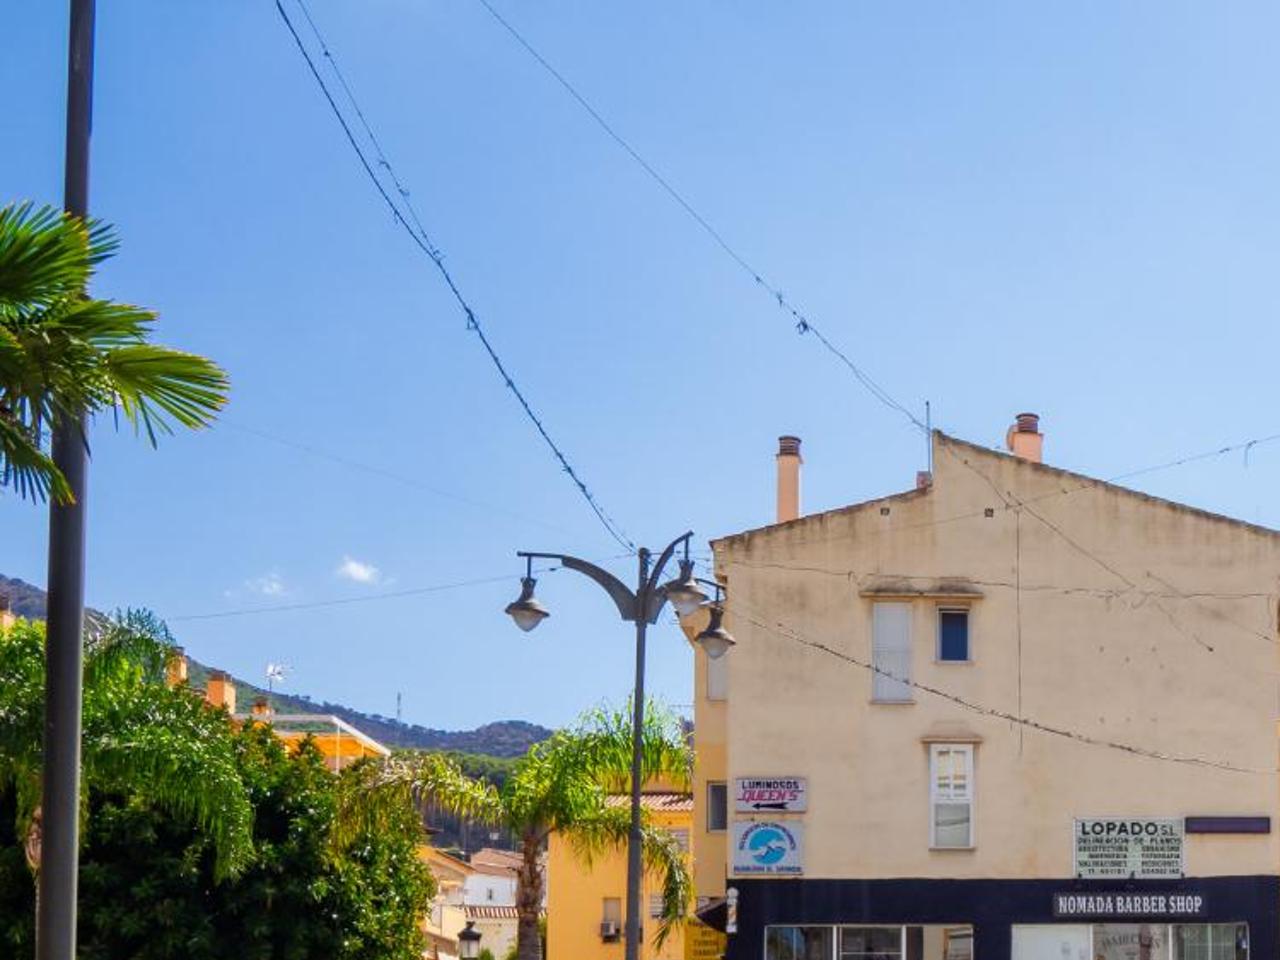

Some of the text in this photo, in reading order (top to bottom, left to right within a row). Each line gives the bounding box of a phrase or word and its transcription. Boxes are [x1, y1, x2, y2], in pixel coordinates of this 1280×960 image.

[741, 781, 800, 790] LUMINOSOS
[741, 790, 802, 802] QUEEN'S
[1081, 822, 1158, 835] LOPADO
[1059, 896, 1202, 913] NOMADA BARBER SHOP
